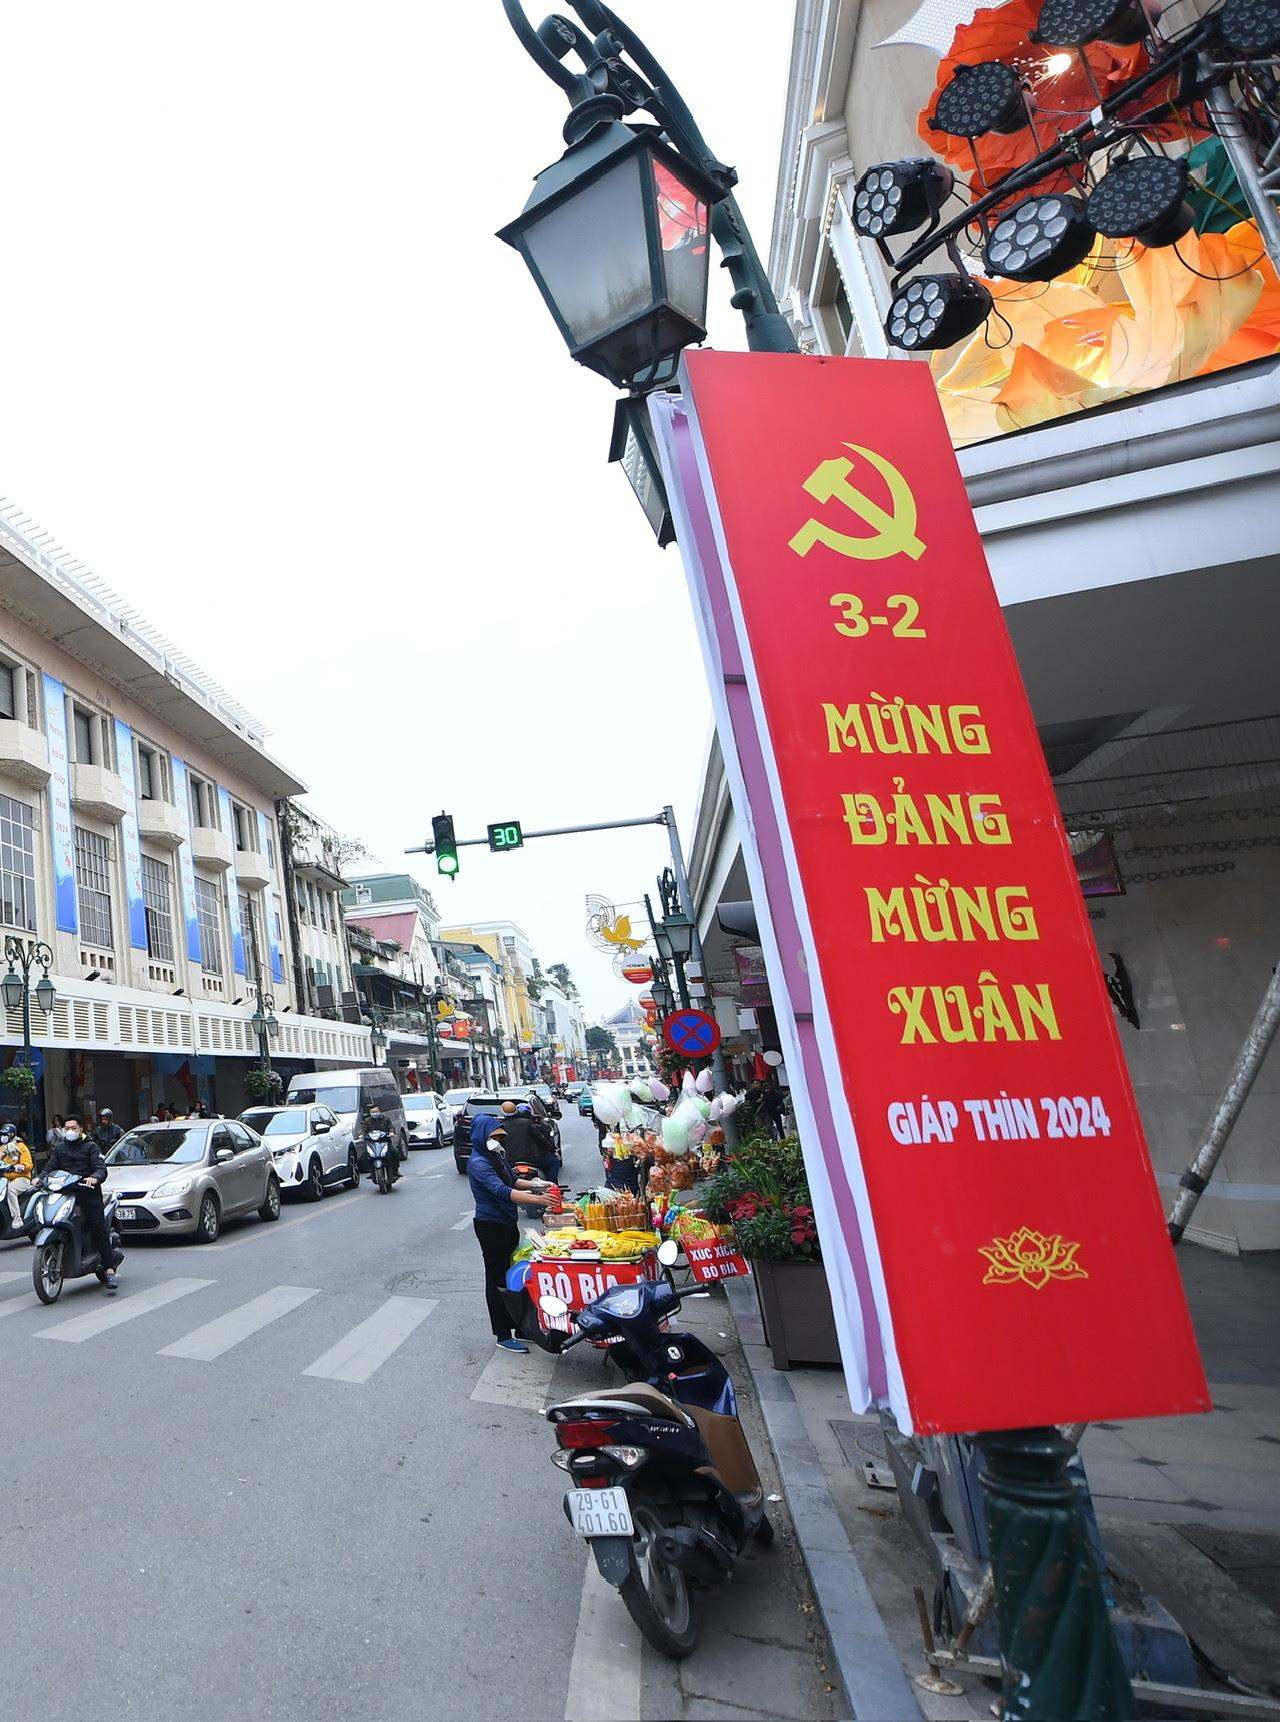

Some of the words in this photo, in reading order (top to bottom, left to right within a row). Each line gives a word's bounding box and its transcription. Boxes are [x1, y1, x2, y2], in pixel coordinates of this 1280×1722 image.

[829, 592, 927, 638] 3-2
[820, 691, 993, 755] MỪNG
[839, 776, 1013, 846] ĐẢNG
[494, 827, 519, 846] 30
[863, 873, 1040, 943] MỪNG
[887, 969, 1063, 1045] XUÂN
[887, 1094, 959, 1146] GIÁP
[963, 1090, 1040, 1141] THÌN
[1040, 1096, 1111, 1139] 2024
[690, 1246, 713, 1262] XÚC
[701, 1263, 719, 1279] BÒ
[720, 1261, 738, 1276] BÍA
[538, 1265, 574, 1305] BÒ
[575, 1490, 618, 1511] 29-G1
